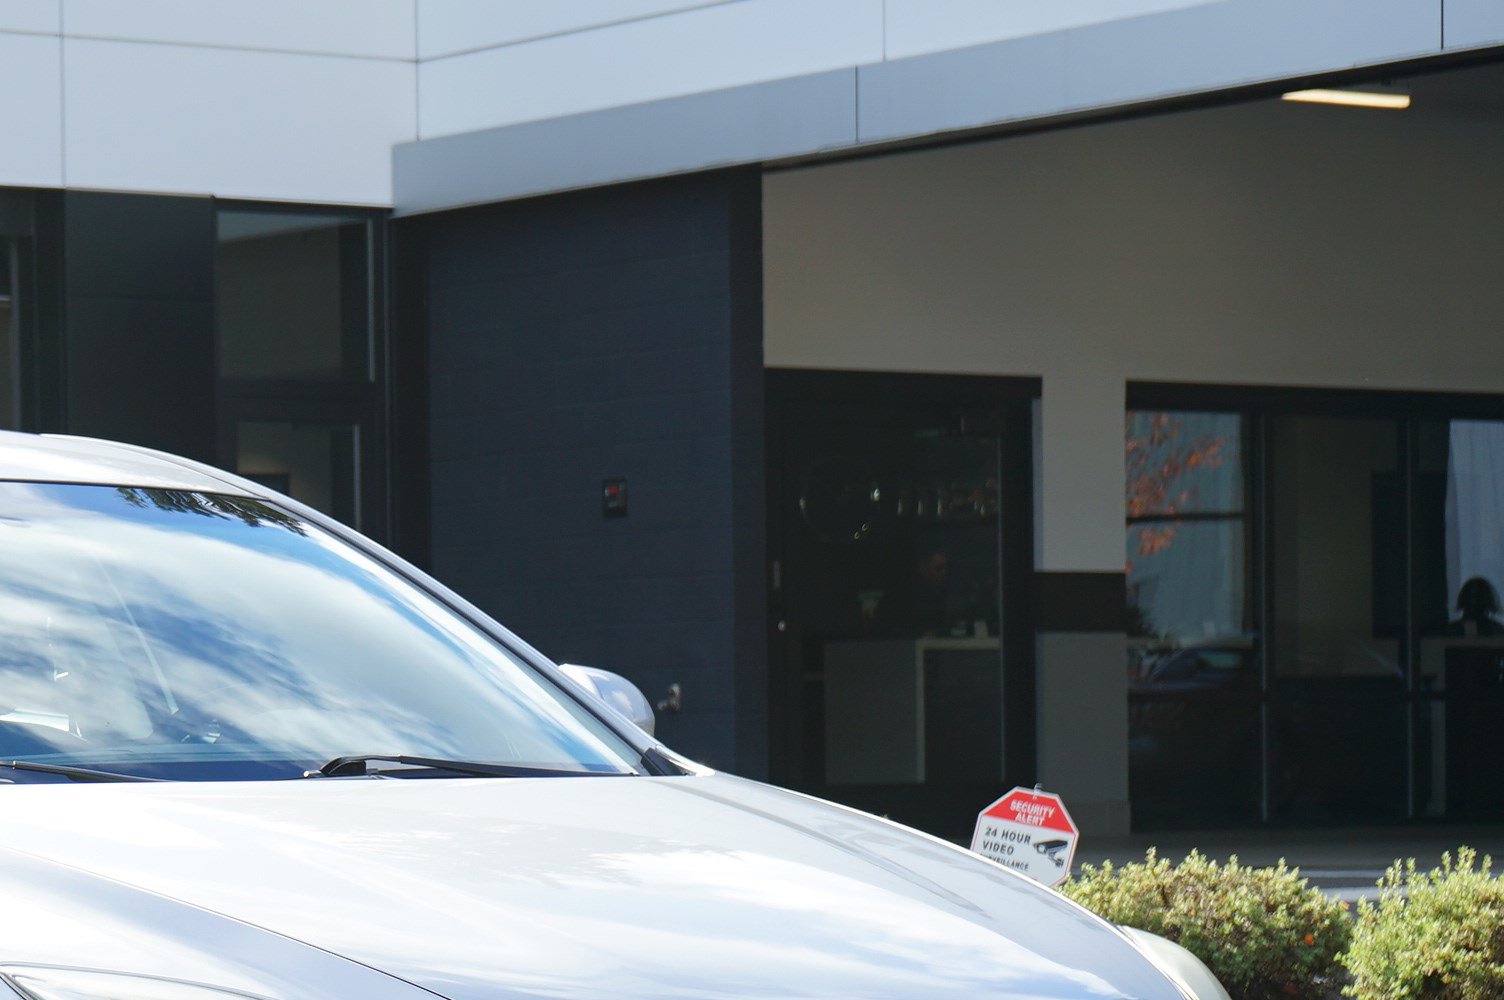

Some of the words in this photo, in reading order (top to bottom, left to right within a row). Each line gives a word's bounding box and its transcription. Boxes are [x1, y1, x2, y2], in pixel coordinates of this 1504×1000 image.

[1010, 799, 1055, 818] SECURITY
[1015, 811, 1045, 826] ALERT
[985, 826, 998, 838] 24
[1001, 829, 1031, 845] HOUR
[983, 840, 1015, 856] VIDEO
[980, 852, 1029, 871] VEILLANCE
